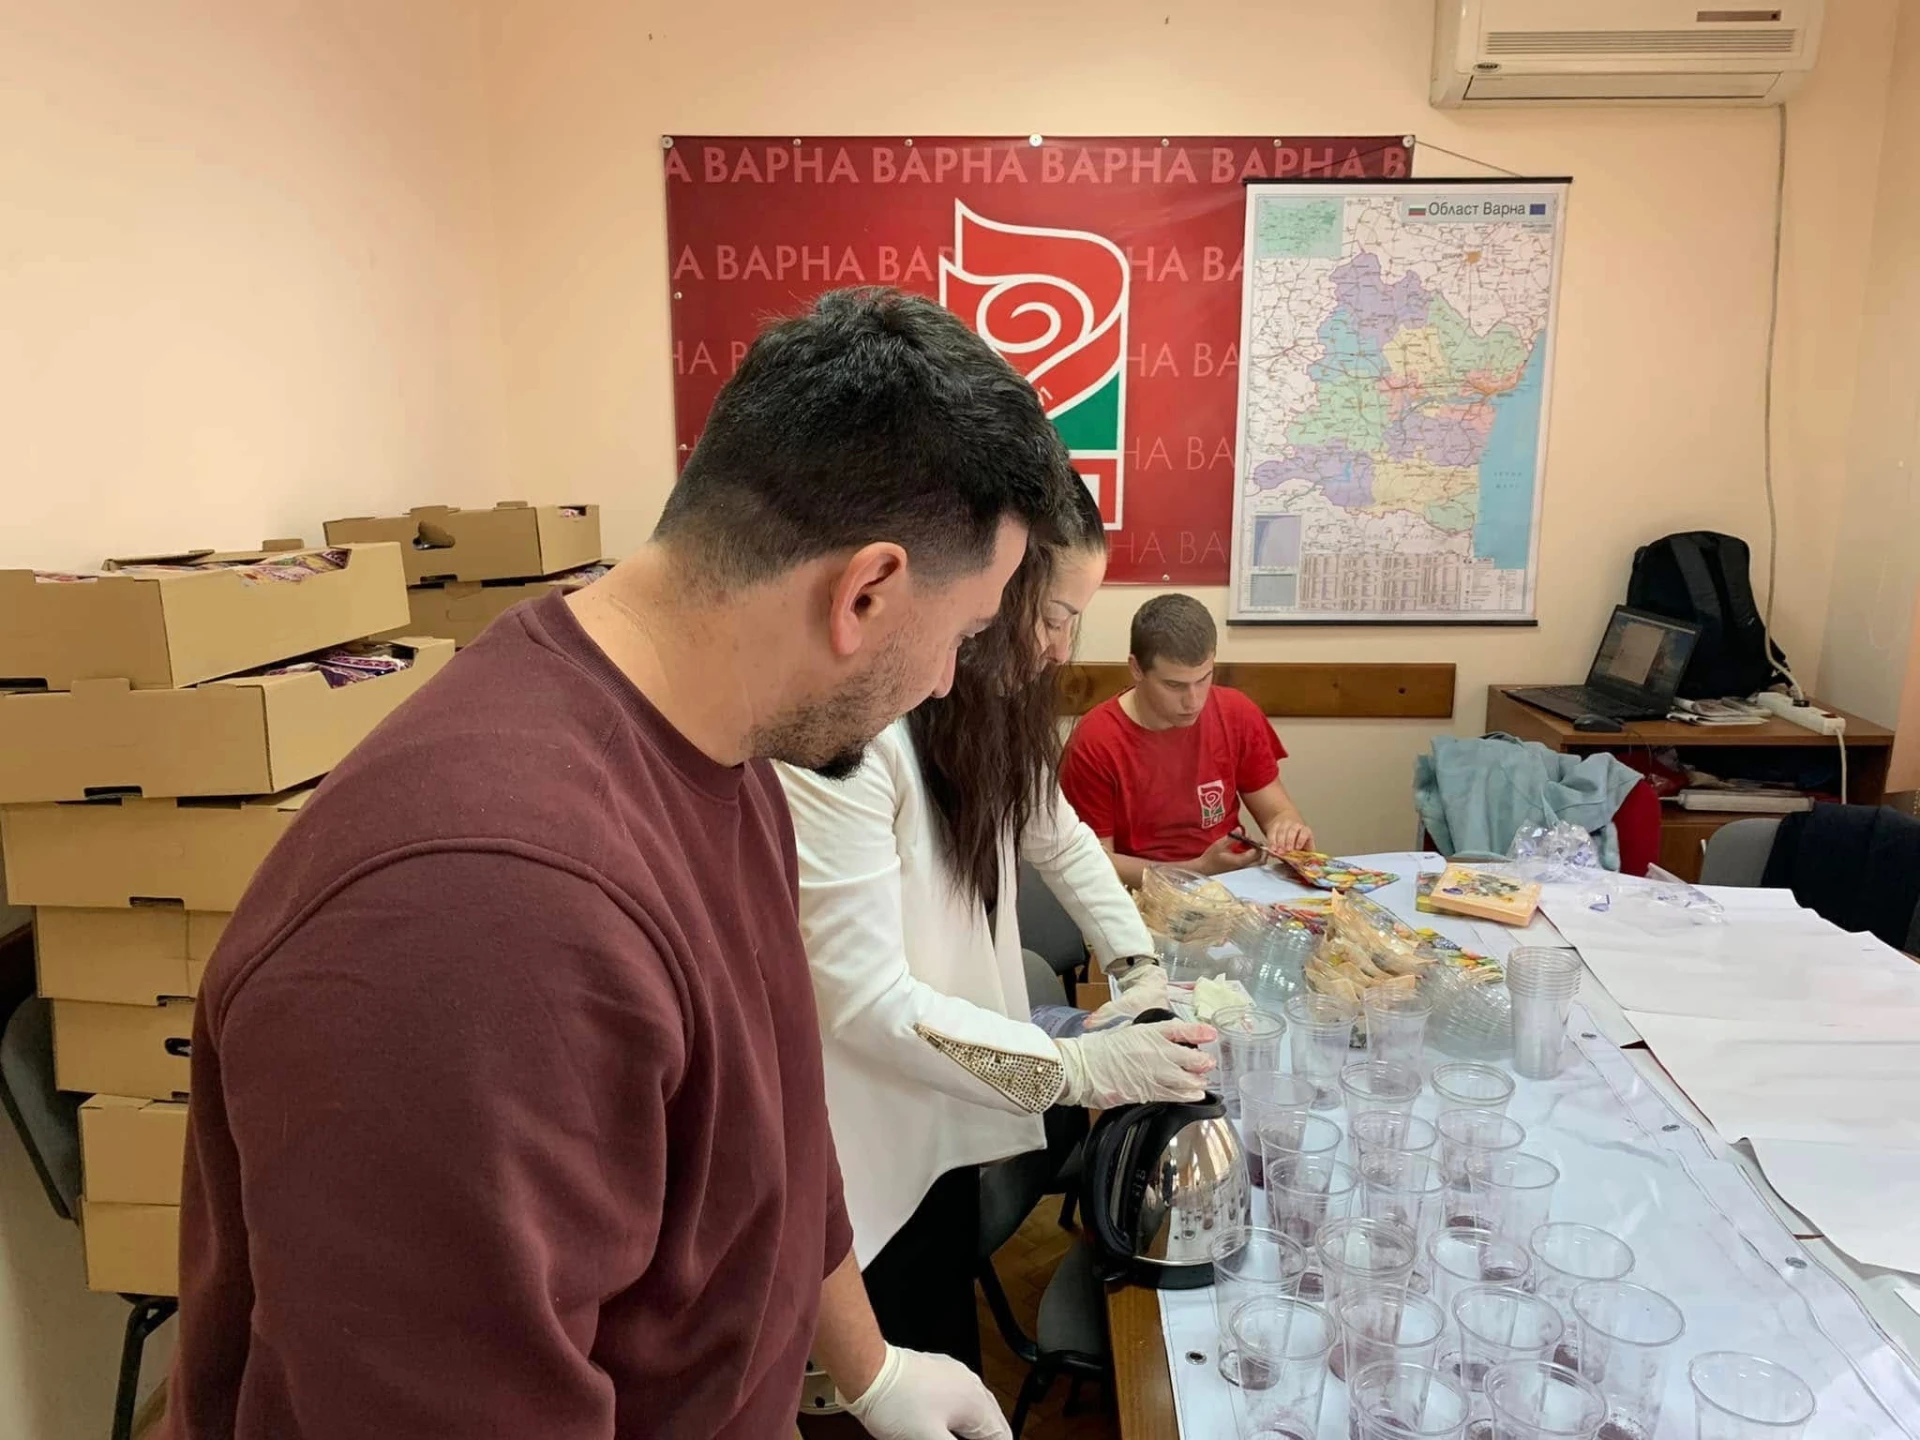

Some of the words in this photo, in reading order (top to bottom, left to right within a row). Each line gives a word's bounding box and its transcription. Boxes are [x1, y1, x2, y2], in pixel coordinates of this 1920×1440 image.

[704, 146, 859, 183] ВАРНА
[872, 147, 1028, 184] ВАРНА
[1042, 147, 1198, 184] ВАРНА
[1211, 147, 1366, 184] ВАРНА
[1428, 202, 1479, 216] Област
[1483, 202, 1526, 218] Варна
[717, 245, 866, 282] ВАРНА
